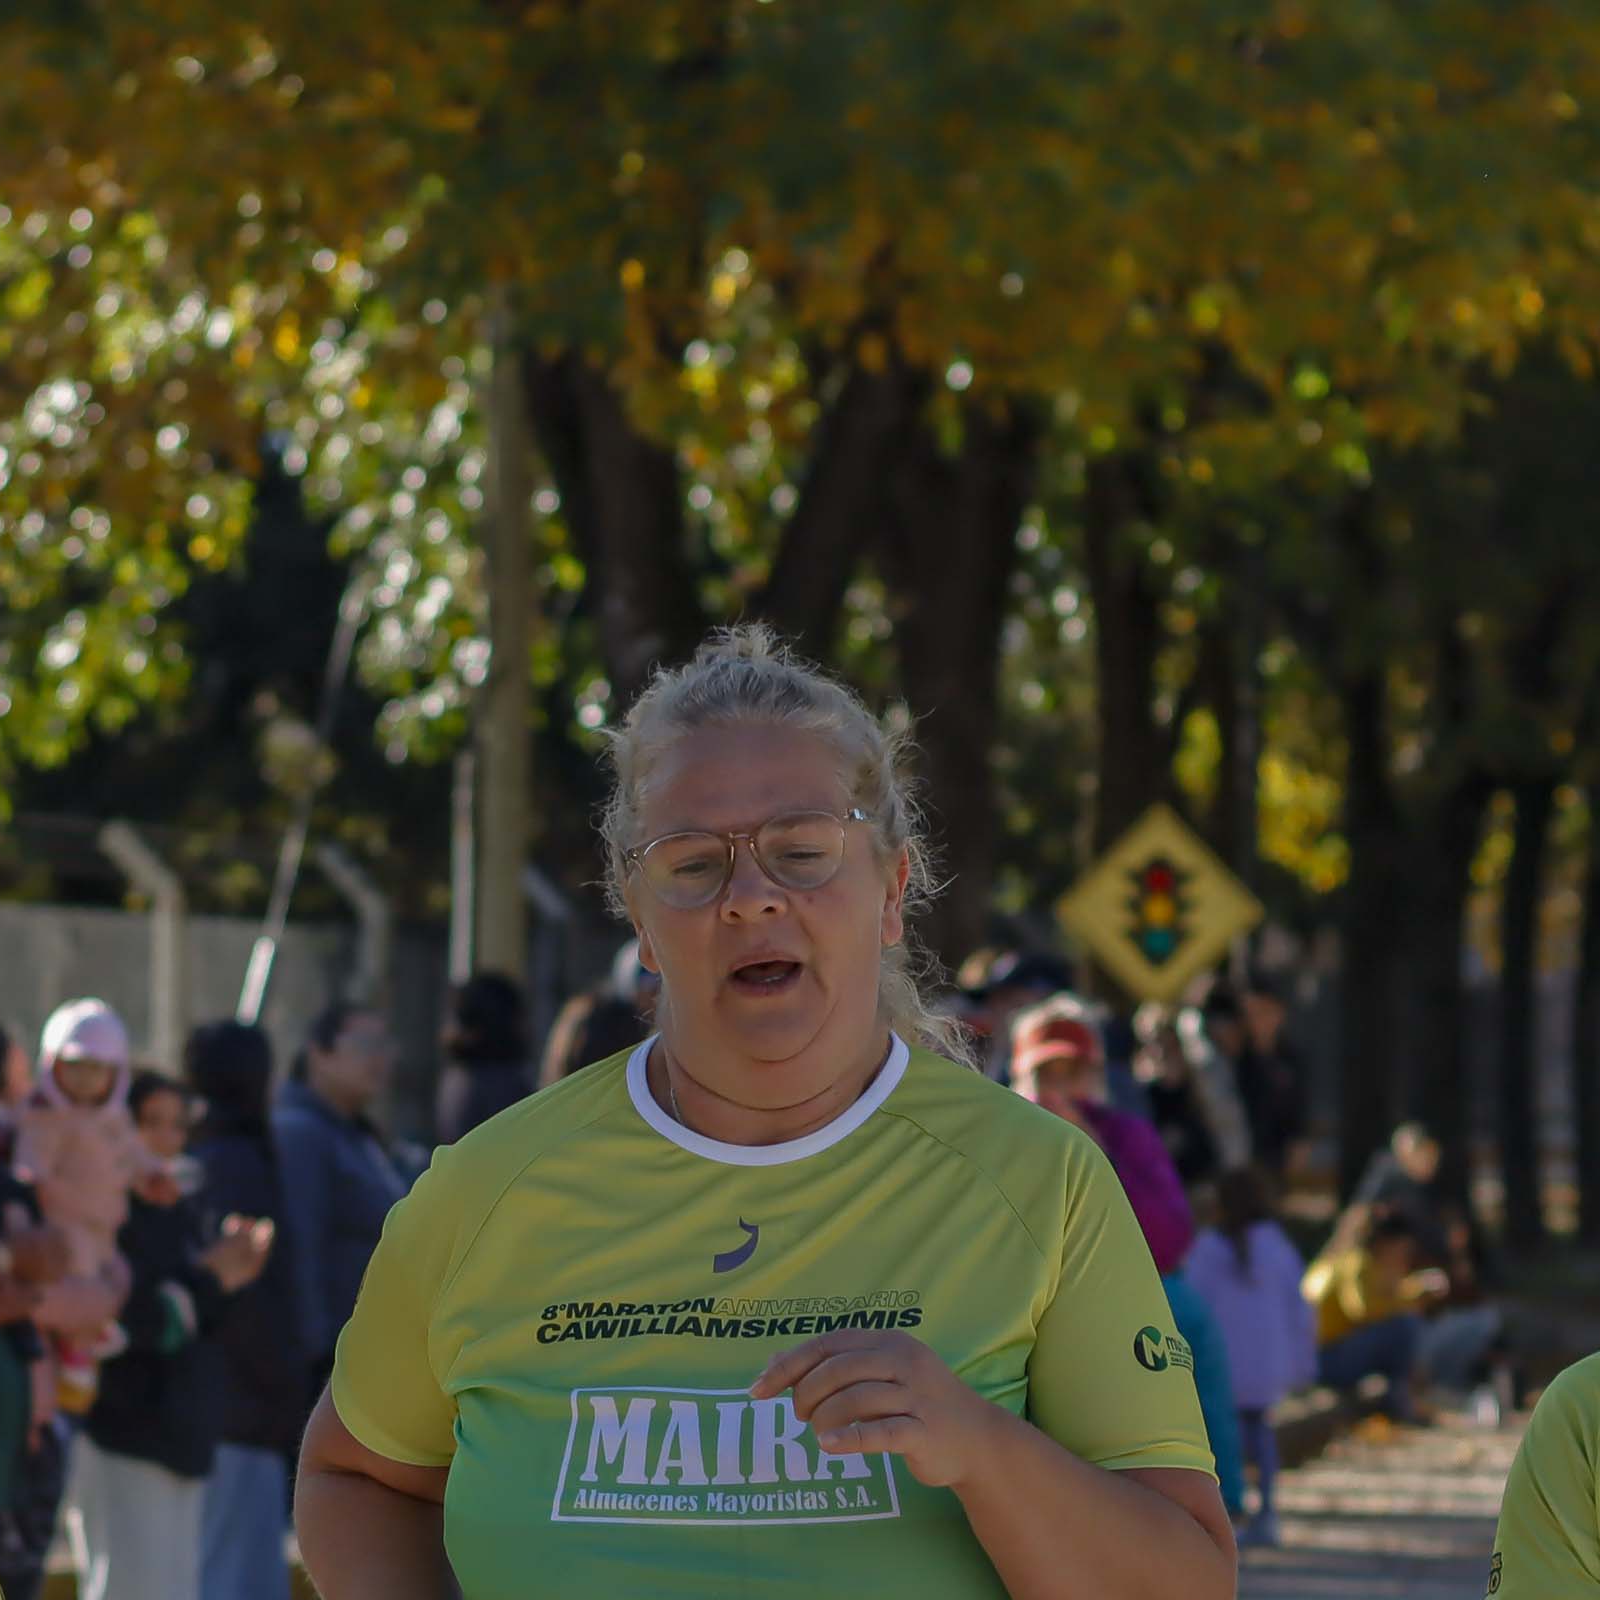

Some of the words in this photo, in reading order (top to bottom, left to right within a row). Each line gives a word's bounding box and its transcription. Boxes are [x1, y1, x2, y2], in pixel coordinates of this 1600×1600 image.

[536, 1307, 923, 1344] CAWILLIAMSKEMMIS
[573, 1488, 699, 1512] Almacenes
[706, 1488, 829, 1515] Mayoristas
[836, 1485, 878, 1508] S.A.
